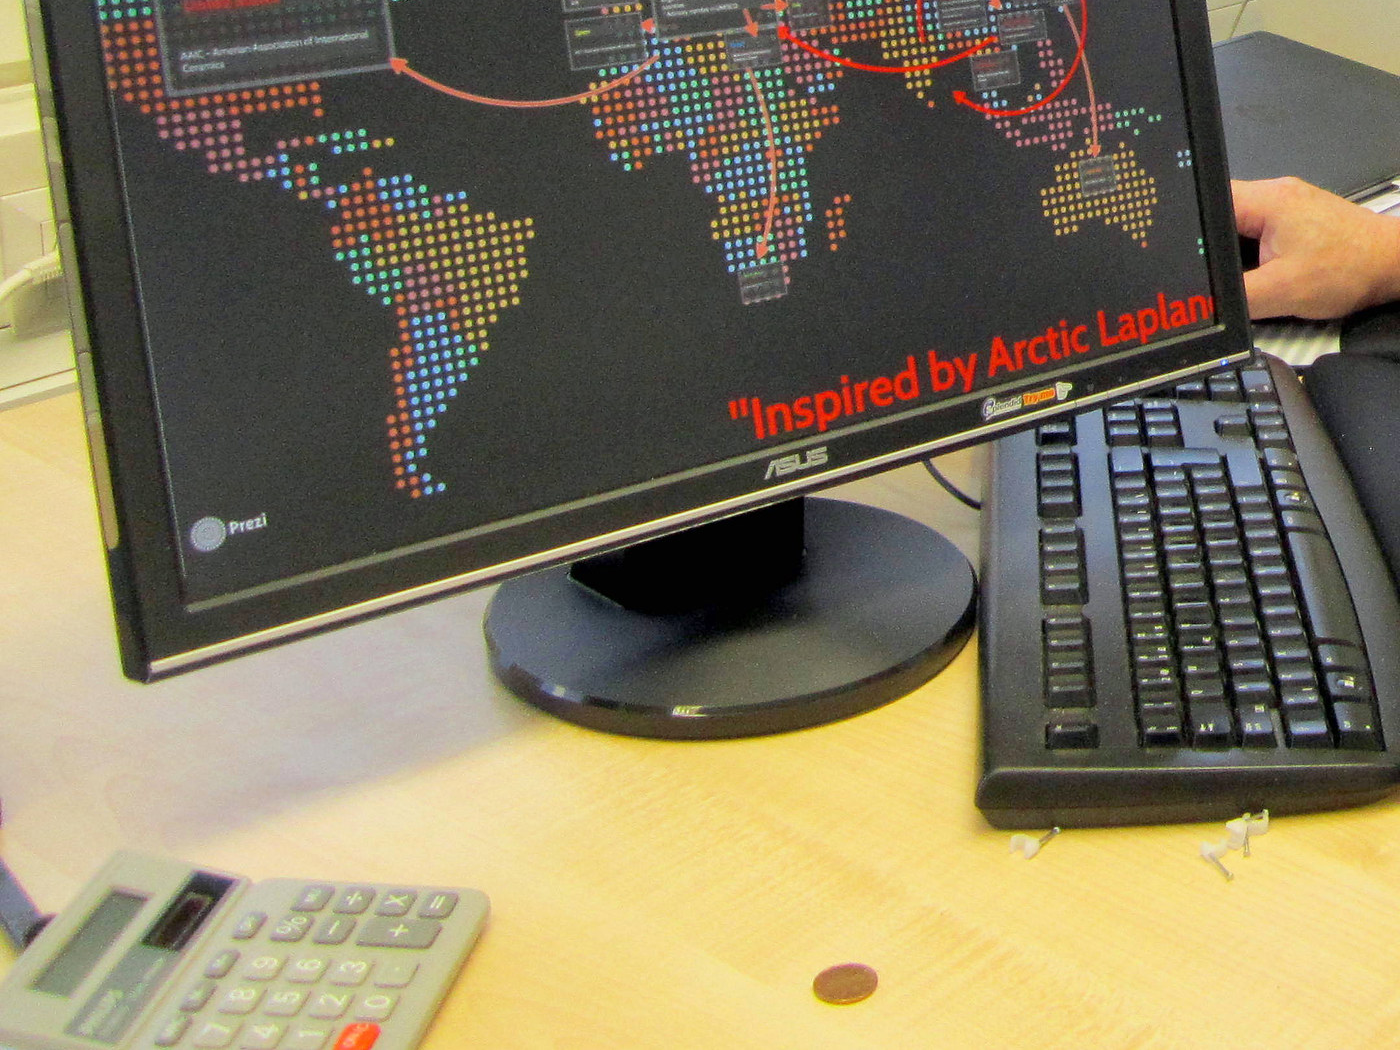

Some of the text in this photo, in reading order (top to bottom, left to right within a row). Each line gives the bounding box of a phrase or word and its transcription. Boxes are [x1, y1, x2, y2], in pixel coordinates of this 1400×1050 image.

[728, 356, 920, 440] "Inspired
[928, 350, 978, 392] by
[988, 319, 1090, 377] Arctic
[764, 446, 829, 481] ASUS
[229, 512, 267, 535] Prezi
